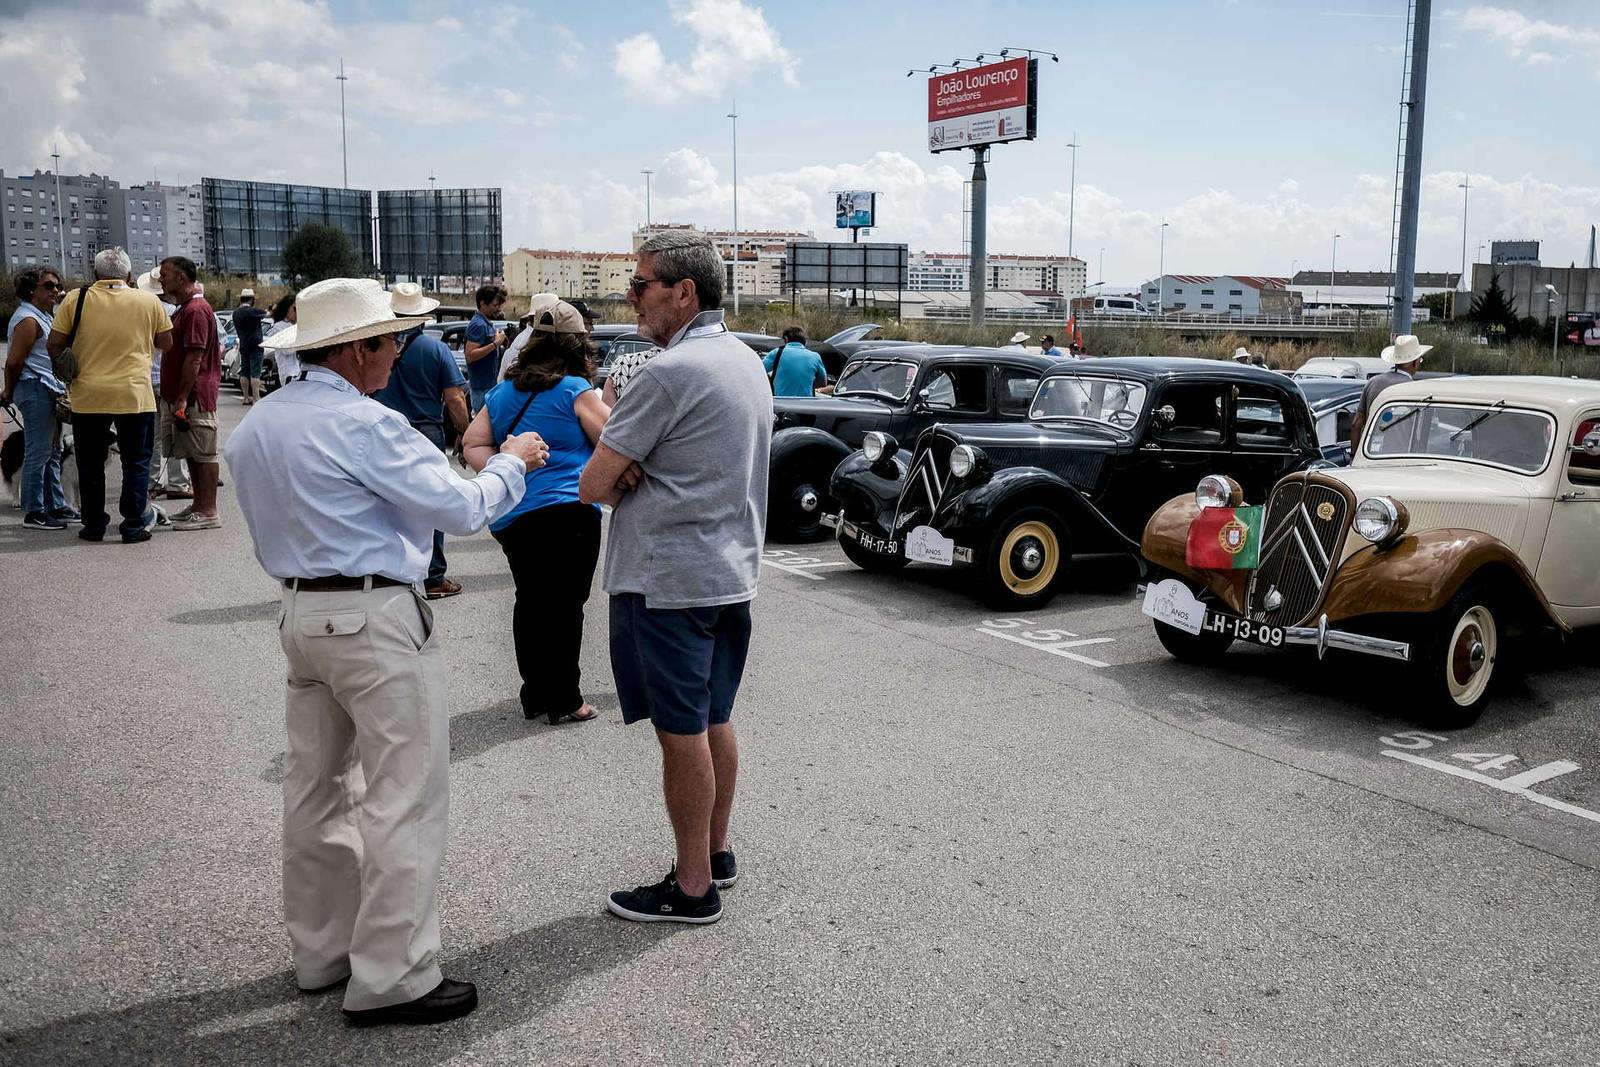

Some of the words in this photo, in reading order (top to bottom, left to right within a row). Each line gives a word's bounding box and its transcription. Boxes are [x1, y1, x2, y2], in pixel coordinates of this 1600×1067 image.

[937, 78, 964, 96] João
[966, 68, 1018, 89] Lourenço
[937, 91, 981, 106] Empilhadores
[860, 532, 898, 554] HH-17-50
[925, 548, 942, 556] ANOS
[1170, 608, 1190, 620] ANOS
[981, 617, 1079, 641] 55
[1202, 611, 1283, 647] LH-13-09
[1378, 731, 1519, 770] 54
